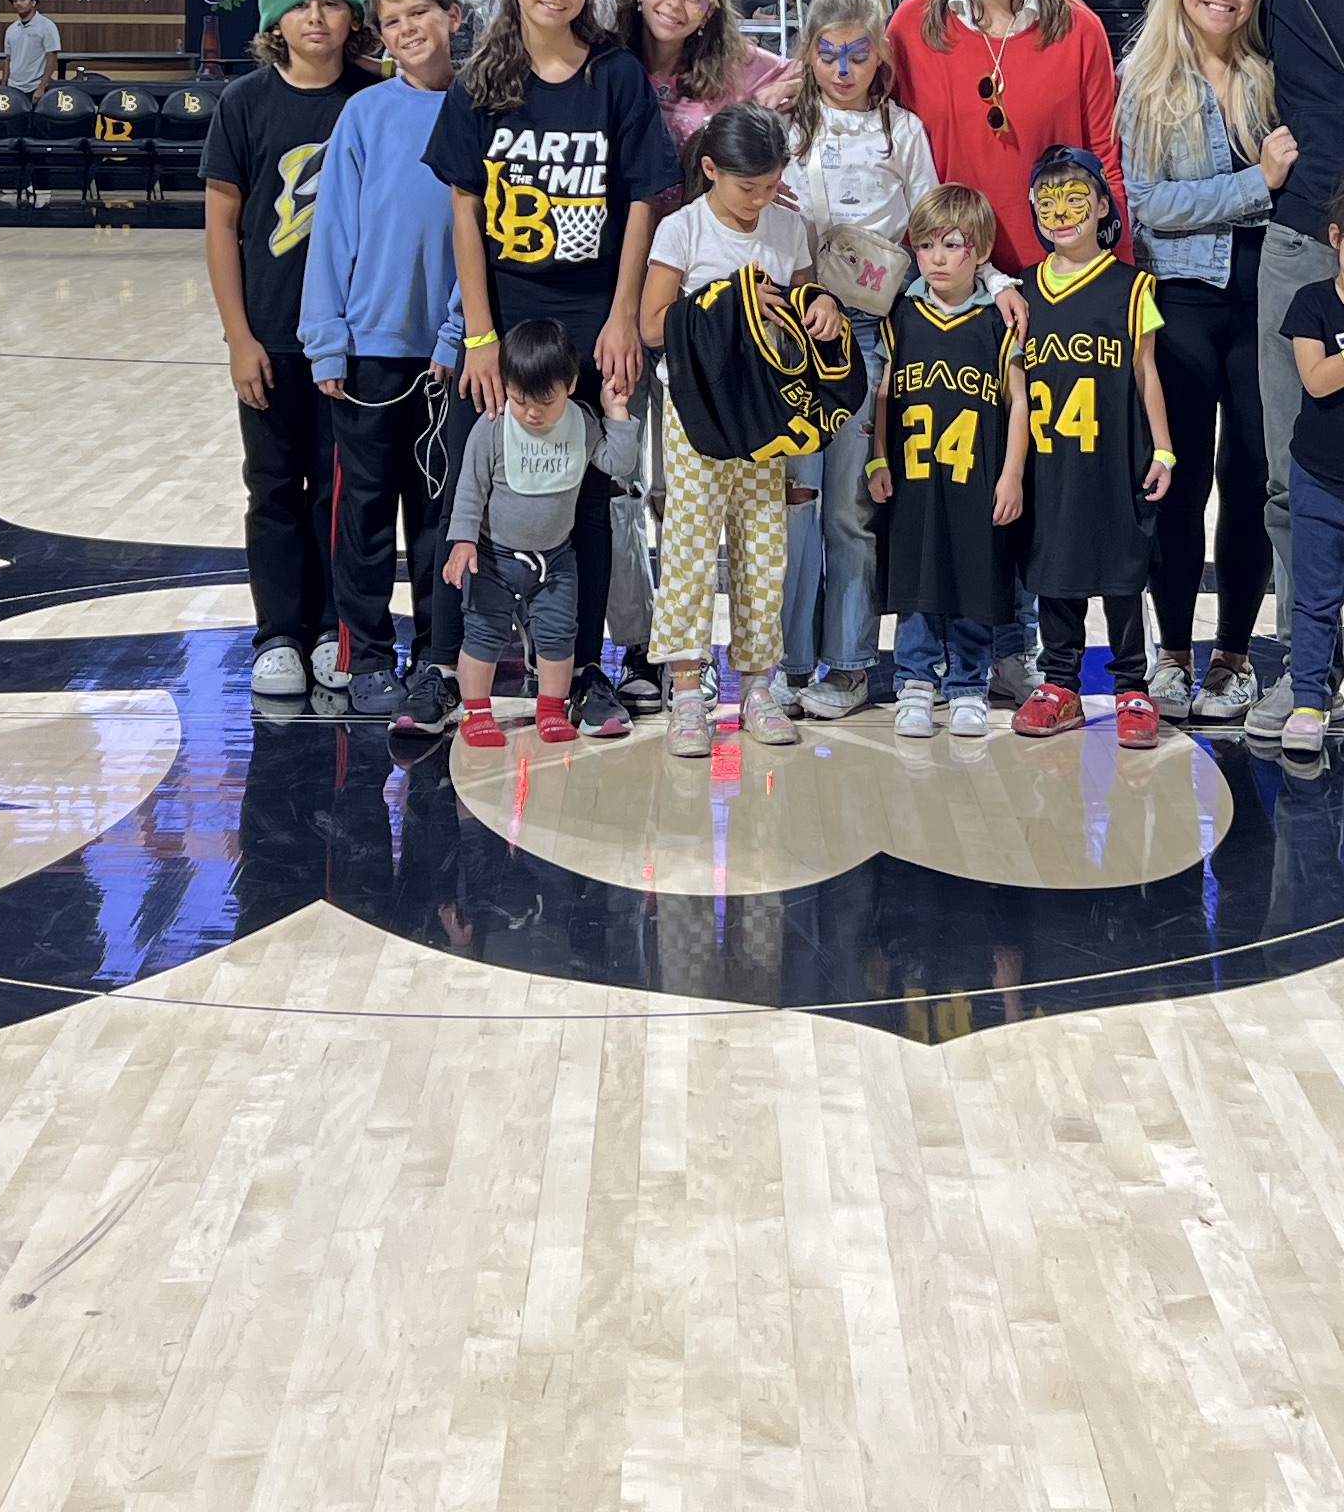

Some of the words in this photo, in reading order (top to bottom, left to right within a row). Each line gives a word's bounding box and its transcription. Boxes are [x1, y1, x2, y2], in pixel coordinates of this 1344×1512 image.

[487, 127, 608, 163] PARTY
[509, 163, 524, 172] IN
[509, 174, 533, 184] THE
[483, 159, 556, 263] LB
[857, 259, 886, 291] M
[1030, 377, 1099, 453] 24
[521, 441, 548, 456] HUG
[554, 441, 570, 455] ME
[902, 403, 979, 484] 24
[521, 456, 570, 474] PLEASE!
